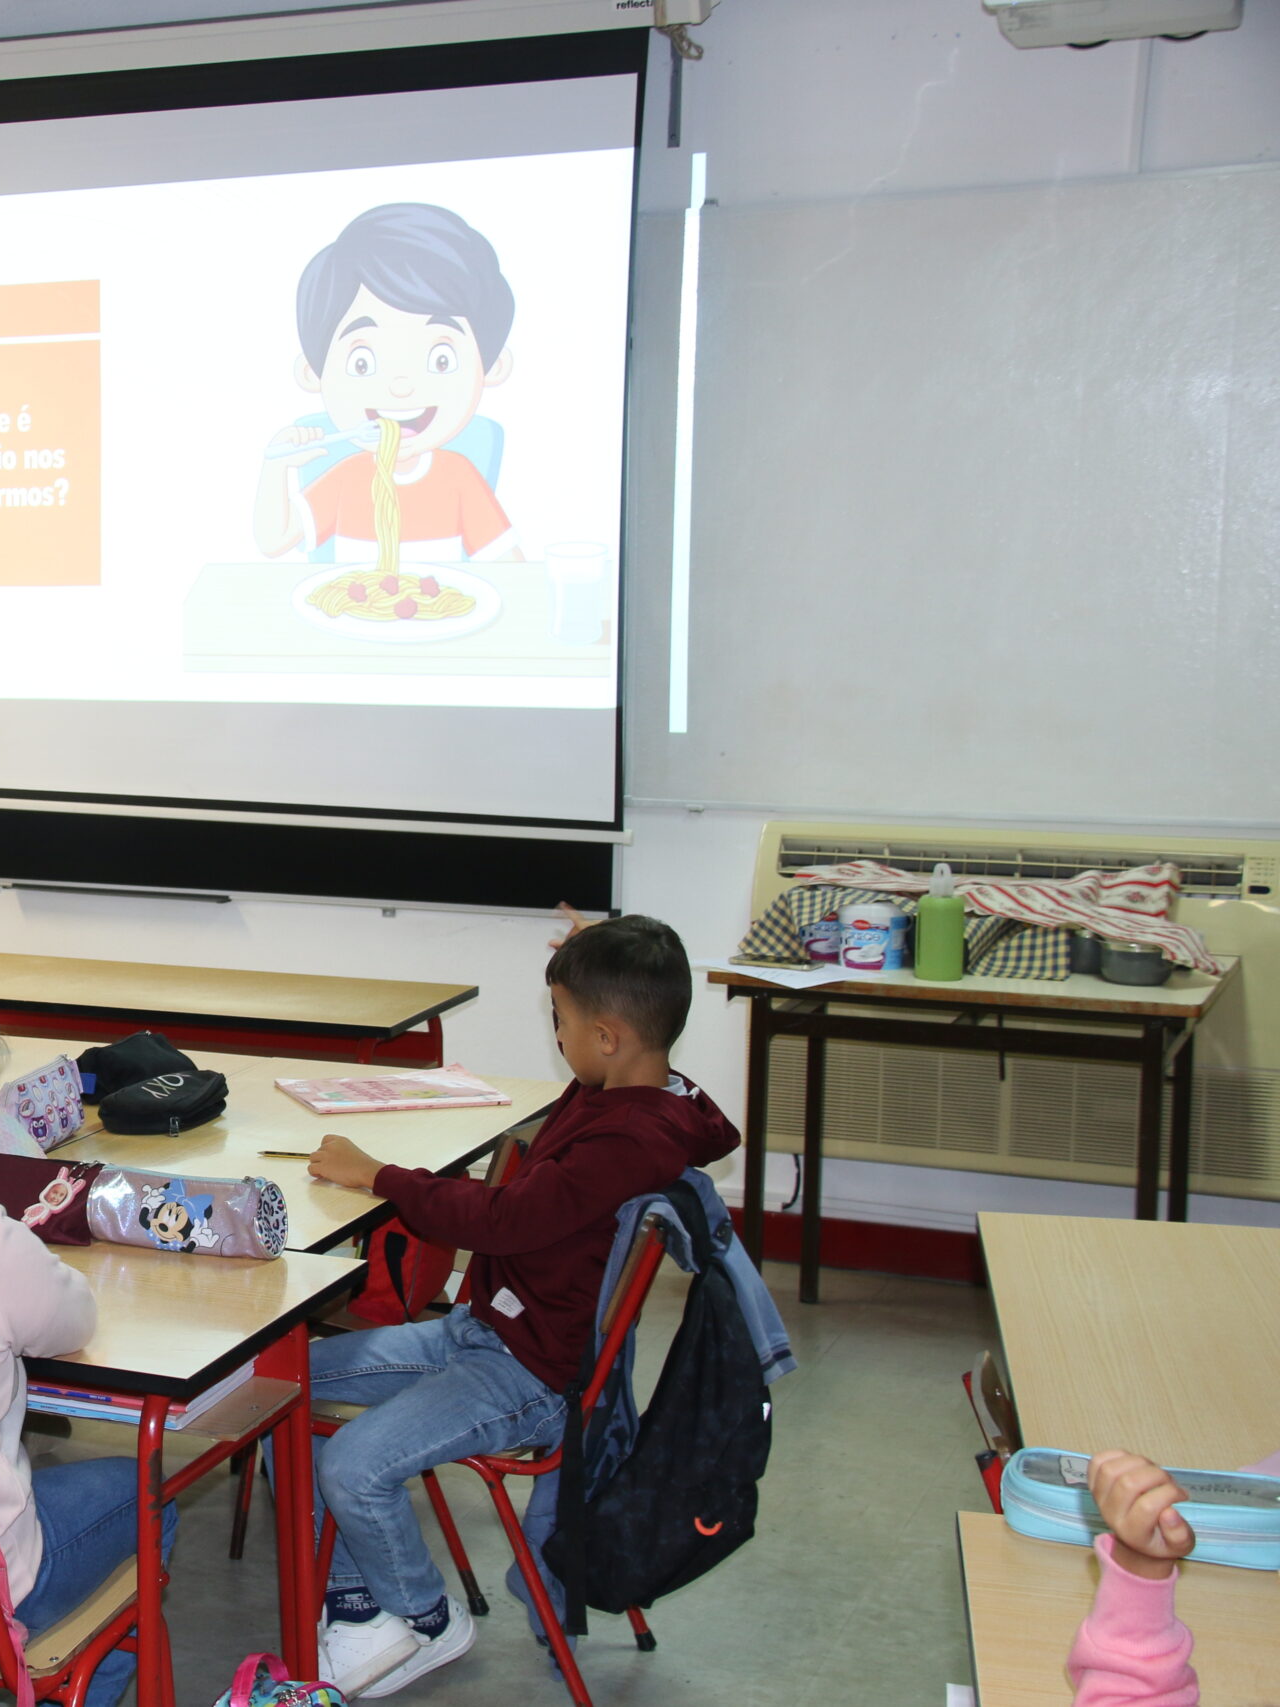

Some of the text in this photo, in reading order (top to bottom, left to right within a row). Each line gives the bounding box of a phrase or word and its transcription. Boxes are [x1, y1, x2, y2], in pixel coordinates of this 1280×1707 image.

[17, 404, 32, 432] é
[24, 448, 65, 469] nos
[141, 1072, 192, 1099] OXY
